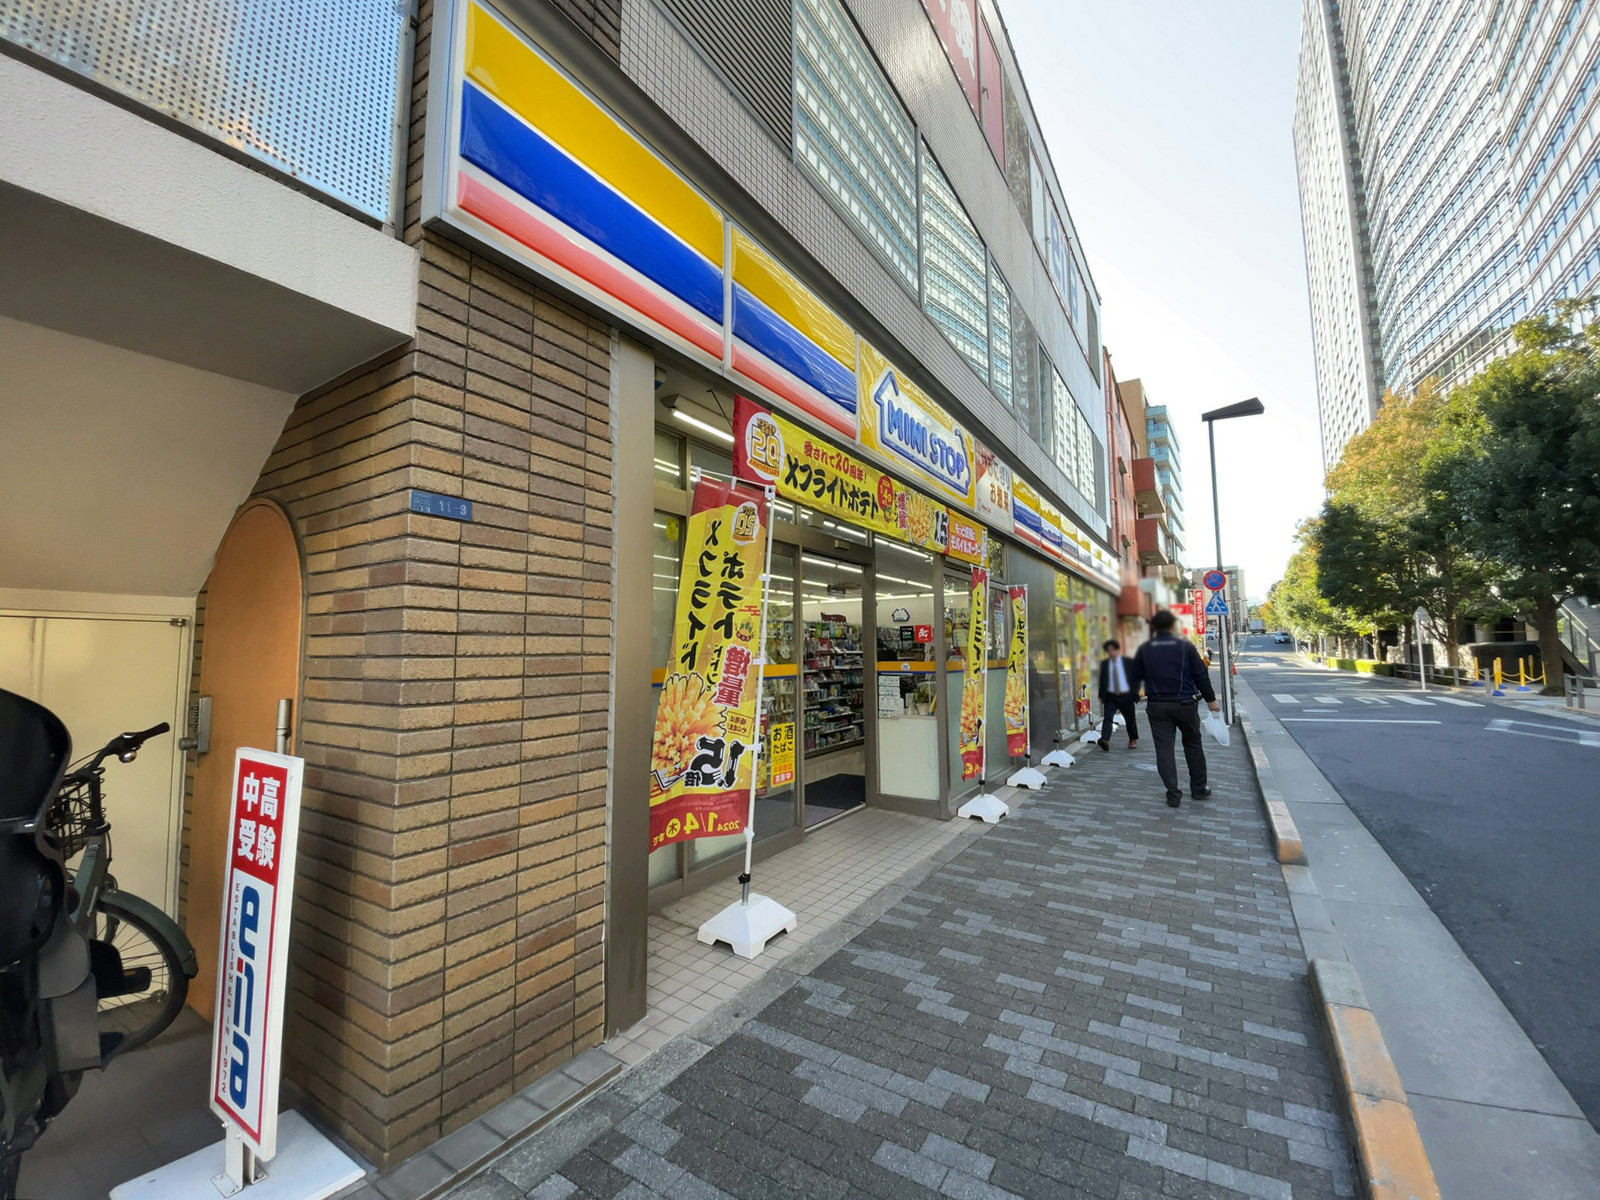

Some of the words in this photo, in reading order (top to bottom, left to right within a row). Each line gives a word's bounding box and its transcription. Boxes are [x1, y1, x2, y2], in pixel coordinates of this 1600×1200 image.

[887, 400, 928, 458] MINI
[930, 432, 967, 480] STOP
[773, 725, 794, 742] お酒
[773, 741, 794, 754] たばこ
[237, 818, 276, 870] 受験
[227, 883, 241, 1008] ESTABLISHED
[229, 885, 260, 1110] ena
[225, 1016, 230, 1036] IN
